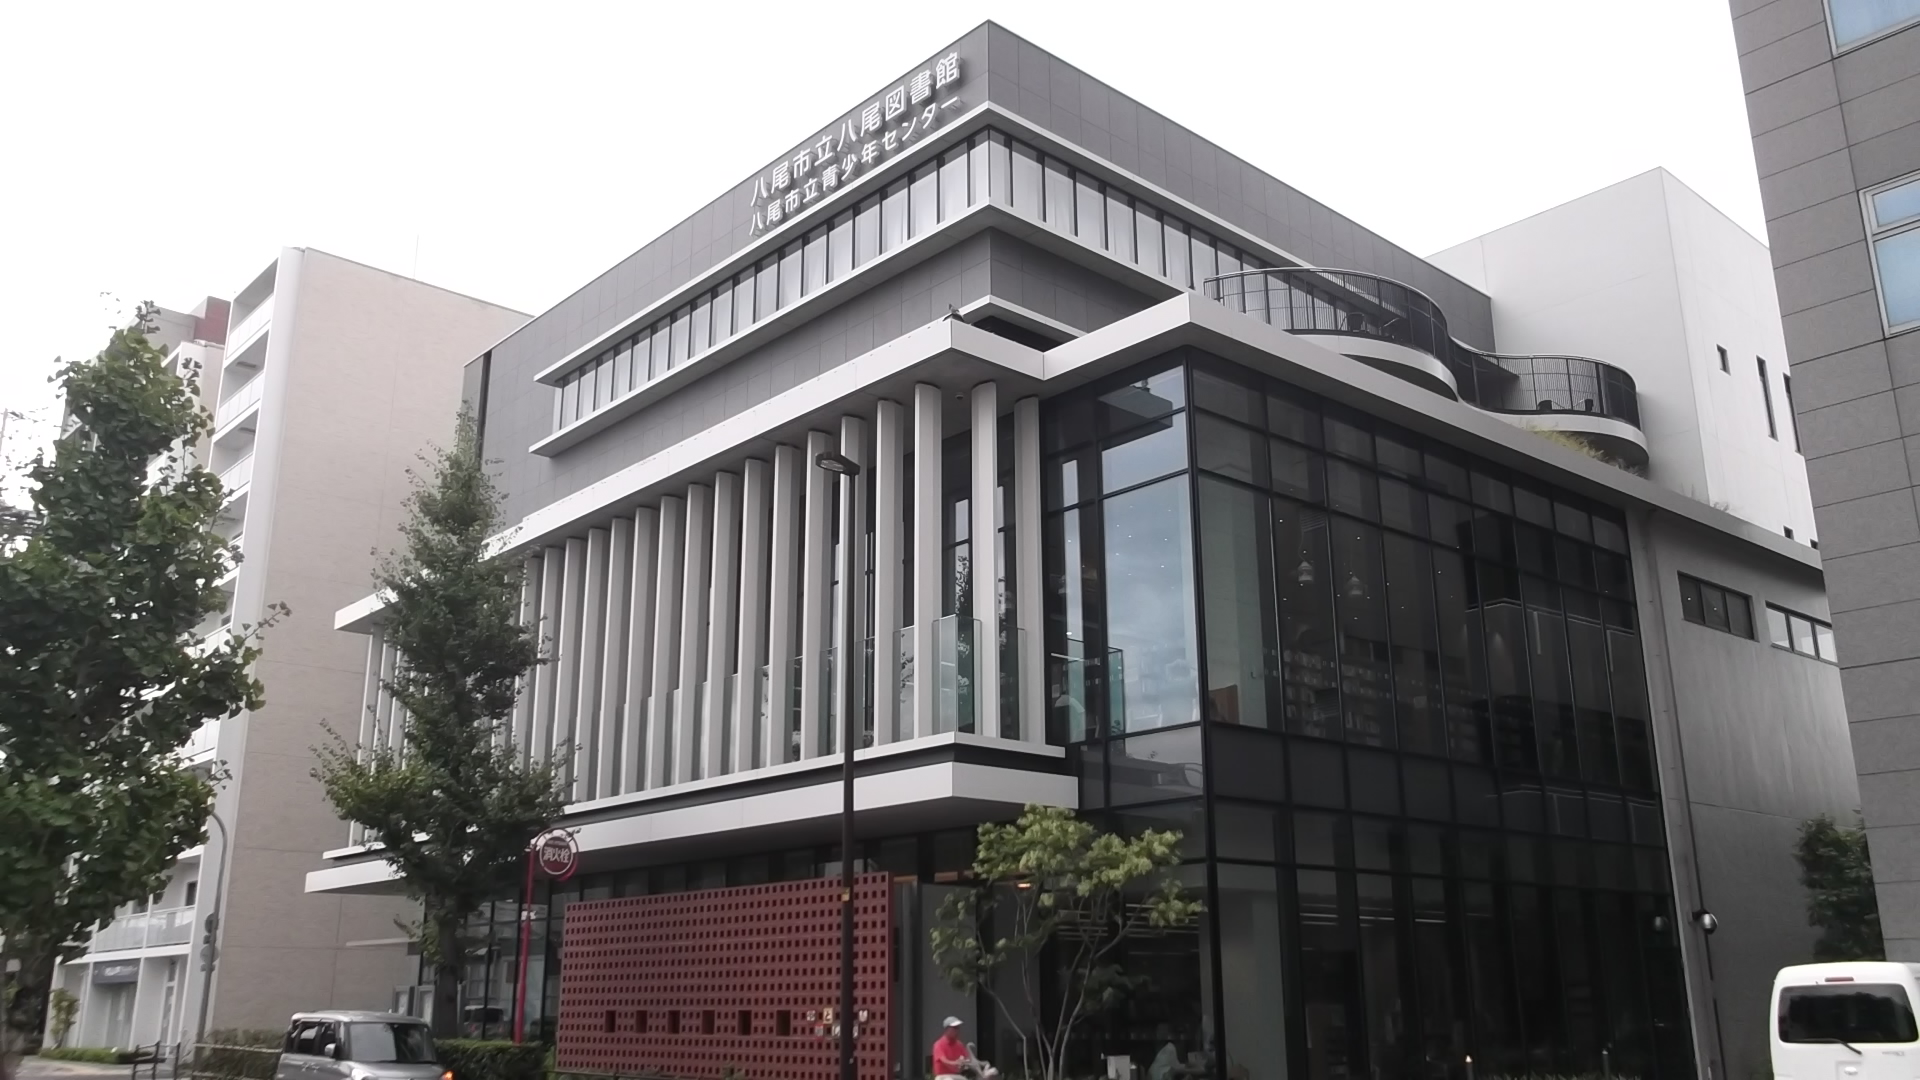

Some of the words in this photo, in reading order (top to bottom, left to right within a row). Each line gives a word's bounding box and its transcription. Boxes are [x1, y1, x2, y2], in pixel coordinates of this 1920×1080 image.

[749, 95, 959, 236] 八尾市立青少年センター
[750, 51, 960, 206] 八尾市立八尾図書館
[543, 846, 570, 863] 消火栓
